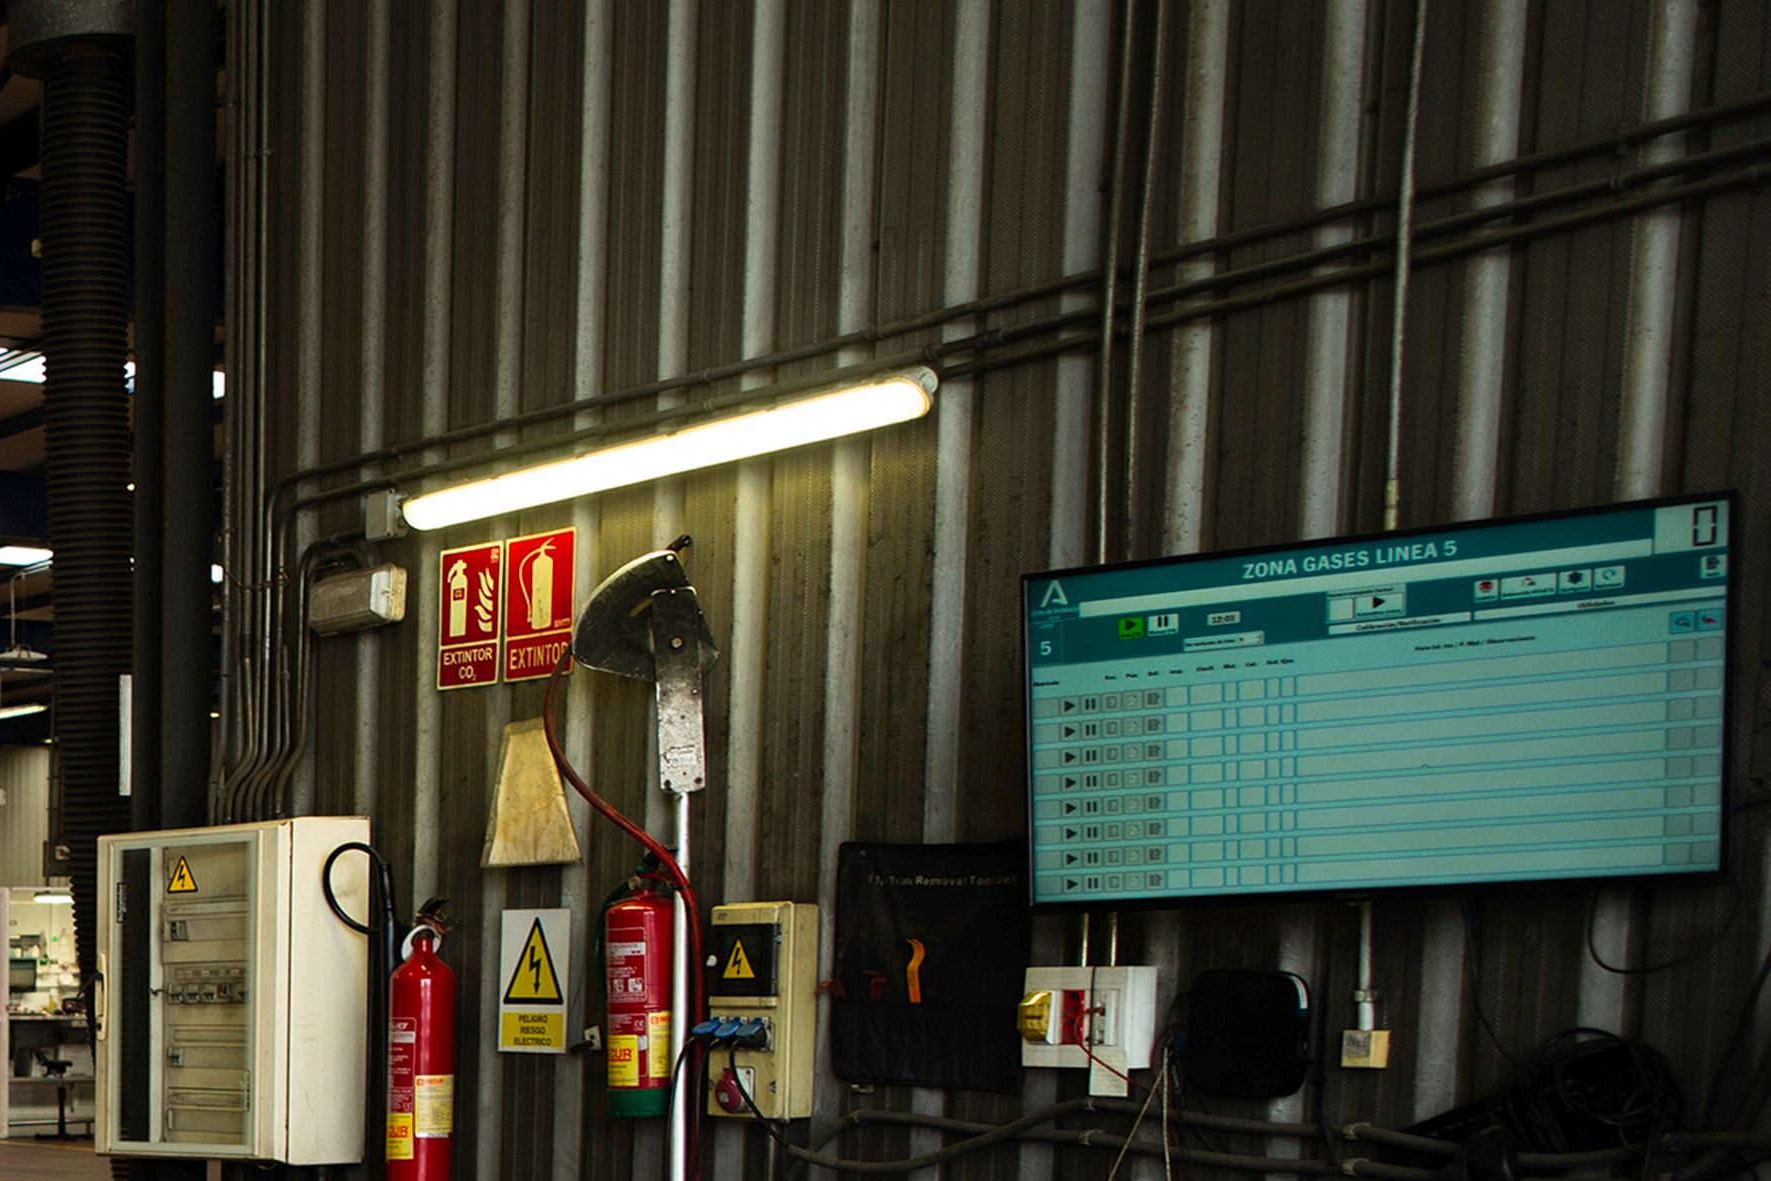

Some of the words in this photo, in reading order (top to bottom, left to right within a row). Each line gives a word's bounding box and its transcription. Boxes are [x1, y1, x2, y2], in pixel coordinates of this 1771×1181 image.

[1693, 506, 1716, 546] 0
[1243, 560, 1297, 579] ZONA
[1303, 550, 1369, 573] GASES
[1376, 541, 1438, 564] LINEA
[1443, 540, 1457, 556] 5
[1040, 641, 1052, 655] 5
[443, 647, 493, 666] EXTINTOR
[518, 1014, 549, 1024] PELIGRO
[520, 1026, 546, 1035] RIESGO
[513, 1036, 552, 1046] ELECTRICO
